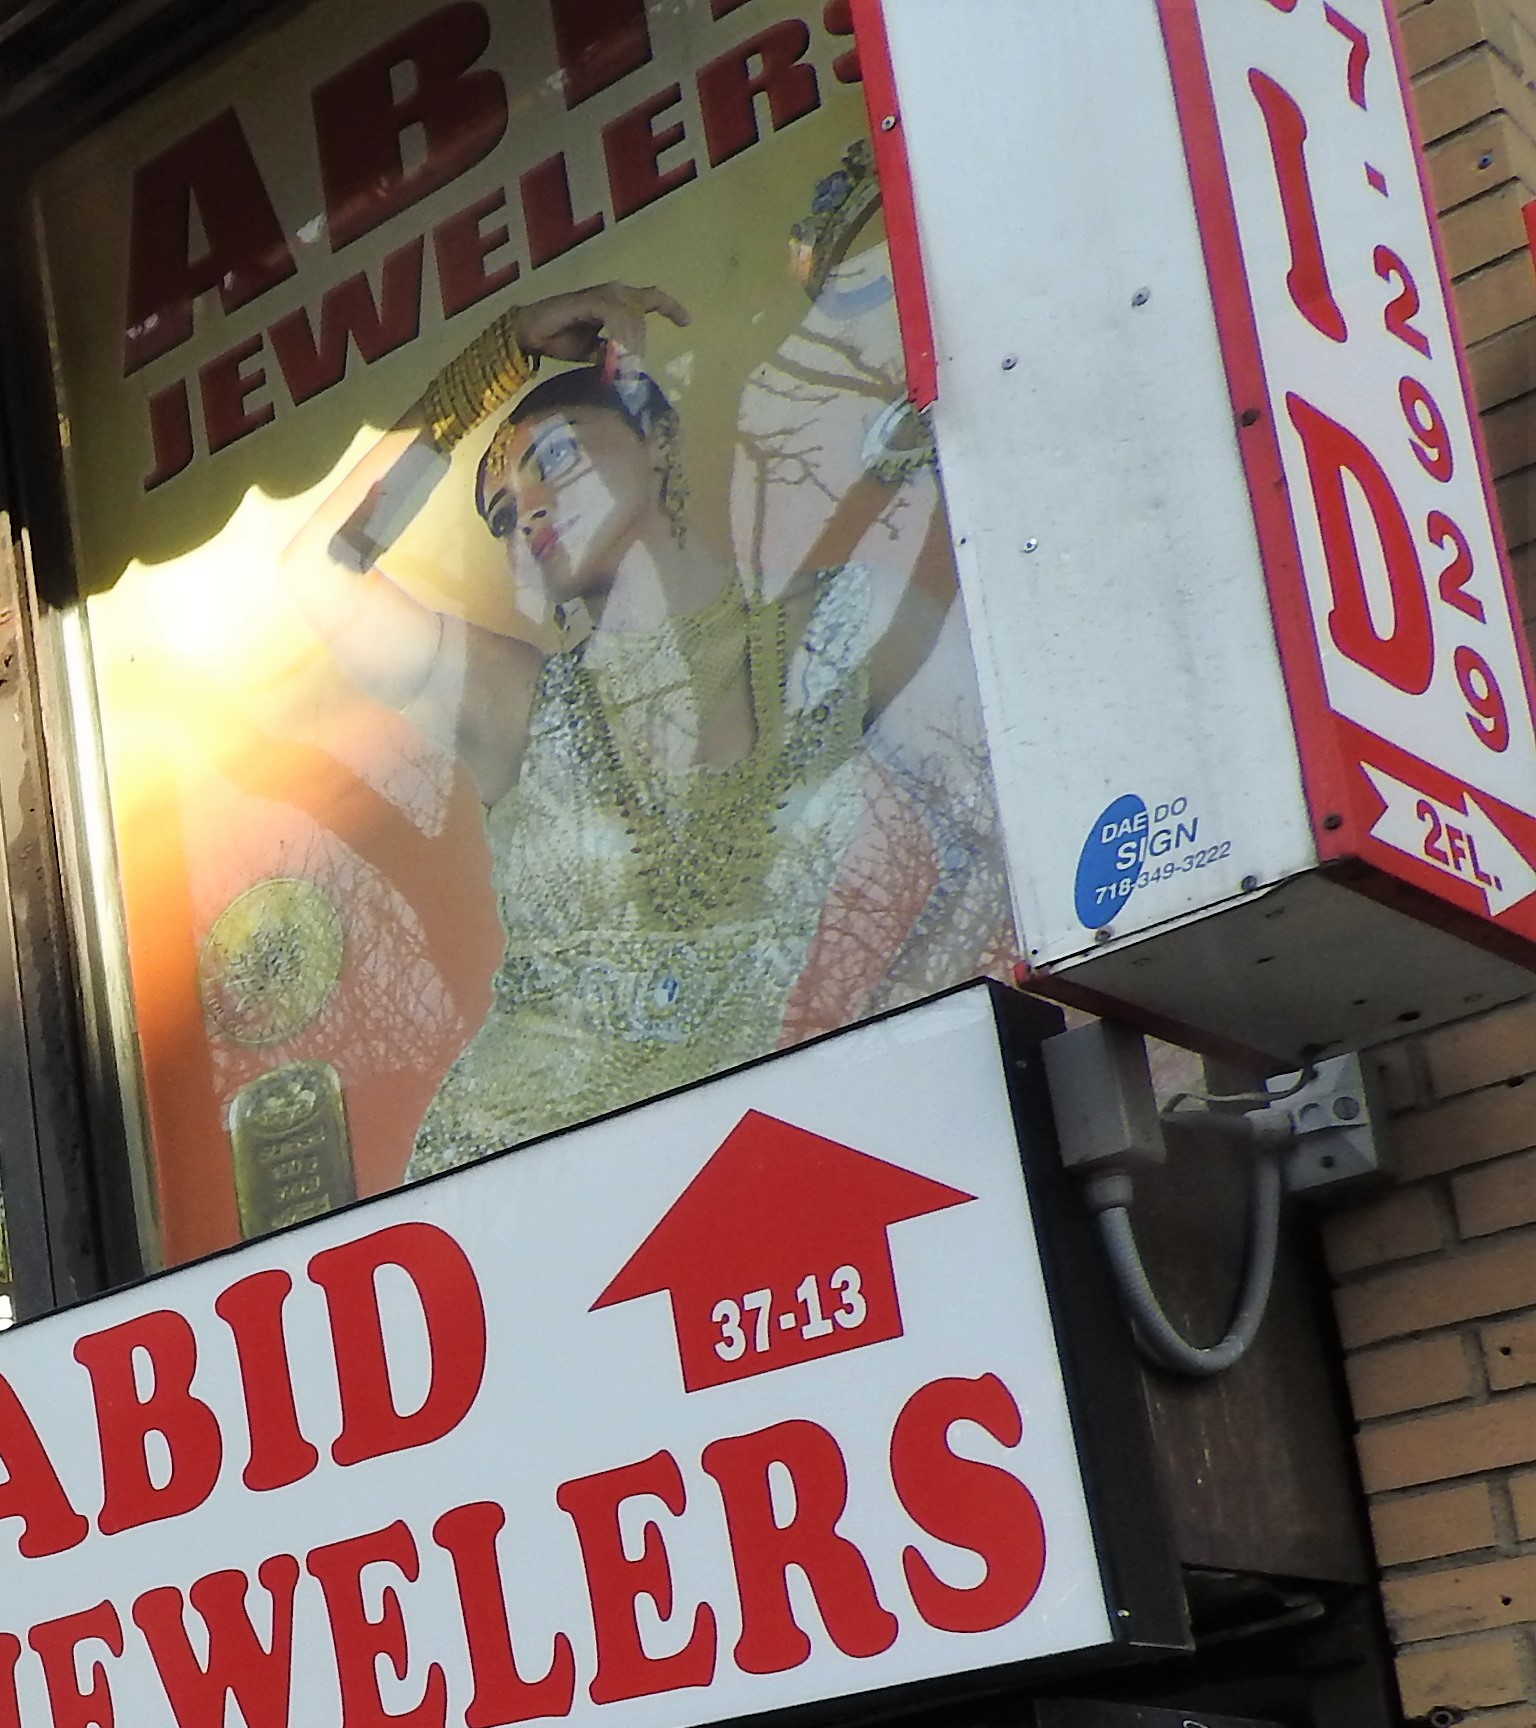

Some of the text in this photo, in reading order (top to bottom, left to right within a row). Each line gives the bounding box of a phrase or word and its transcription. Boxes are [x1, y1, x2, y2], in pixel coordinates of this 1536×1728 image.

[1101, 796, 1188, 844] DAE DO
[1116, 817, 1199, 871] SIGN
[1095, 840, 1232, 905] 718-349-3222
[711, 1263, 869, 1362] 37-13
